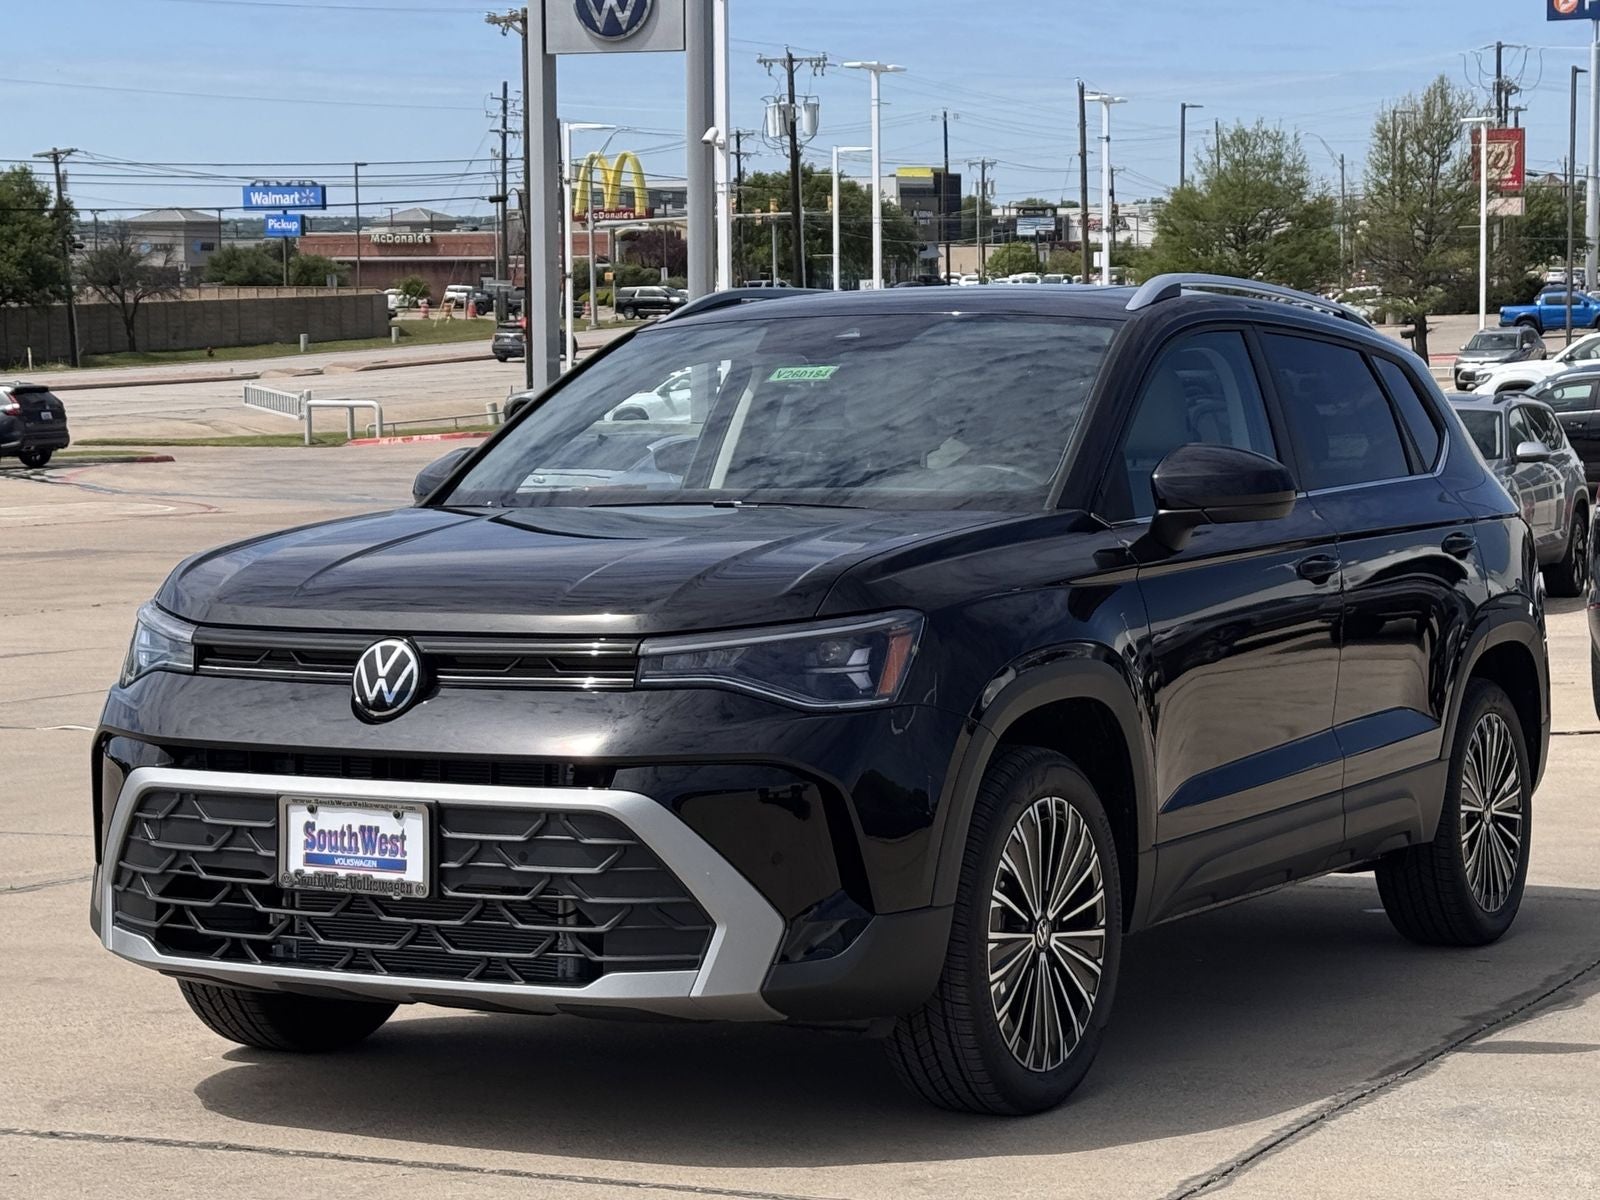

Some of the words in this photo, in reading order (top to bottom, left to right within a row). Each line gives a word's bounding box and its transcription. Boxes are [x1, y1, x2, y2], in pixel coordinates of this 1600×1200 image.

[250, 191, 300, 205] Walmart
[267, 218, 299, 231] Pickup
[370, 233, 432, 244] McDonald's
[356, 639, 417, 711] VW
[302, 819, 408, 859] SouthWest
[333, 856, 378, 868] VOLKSWAGEN
